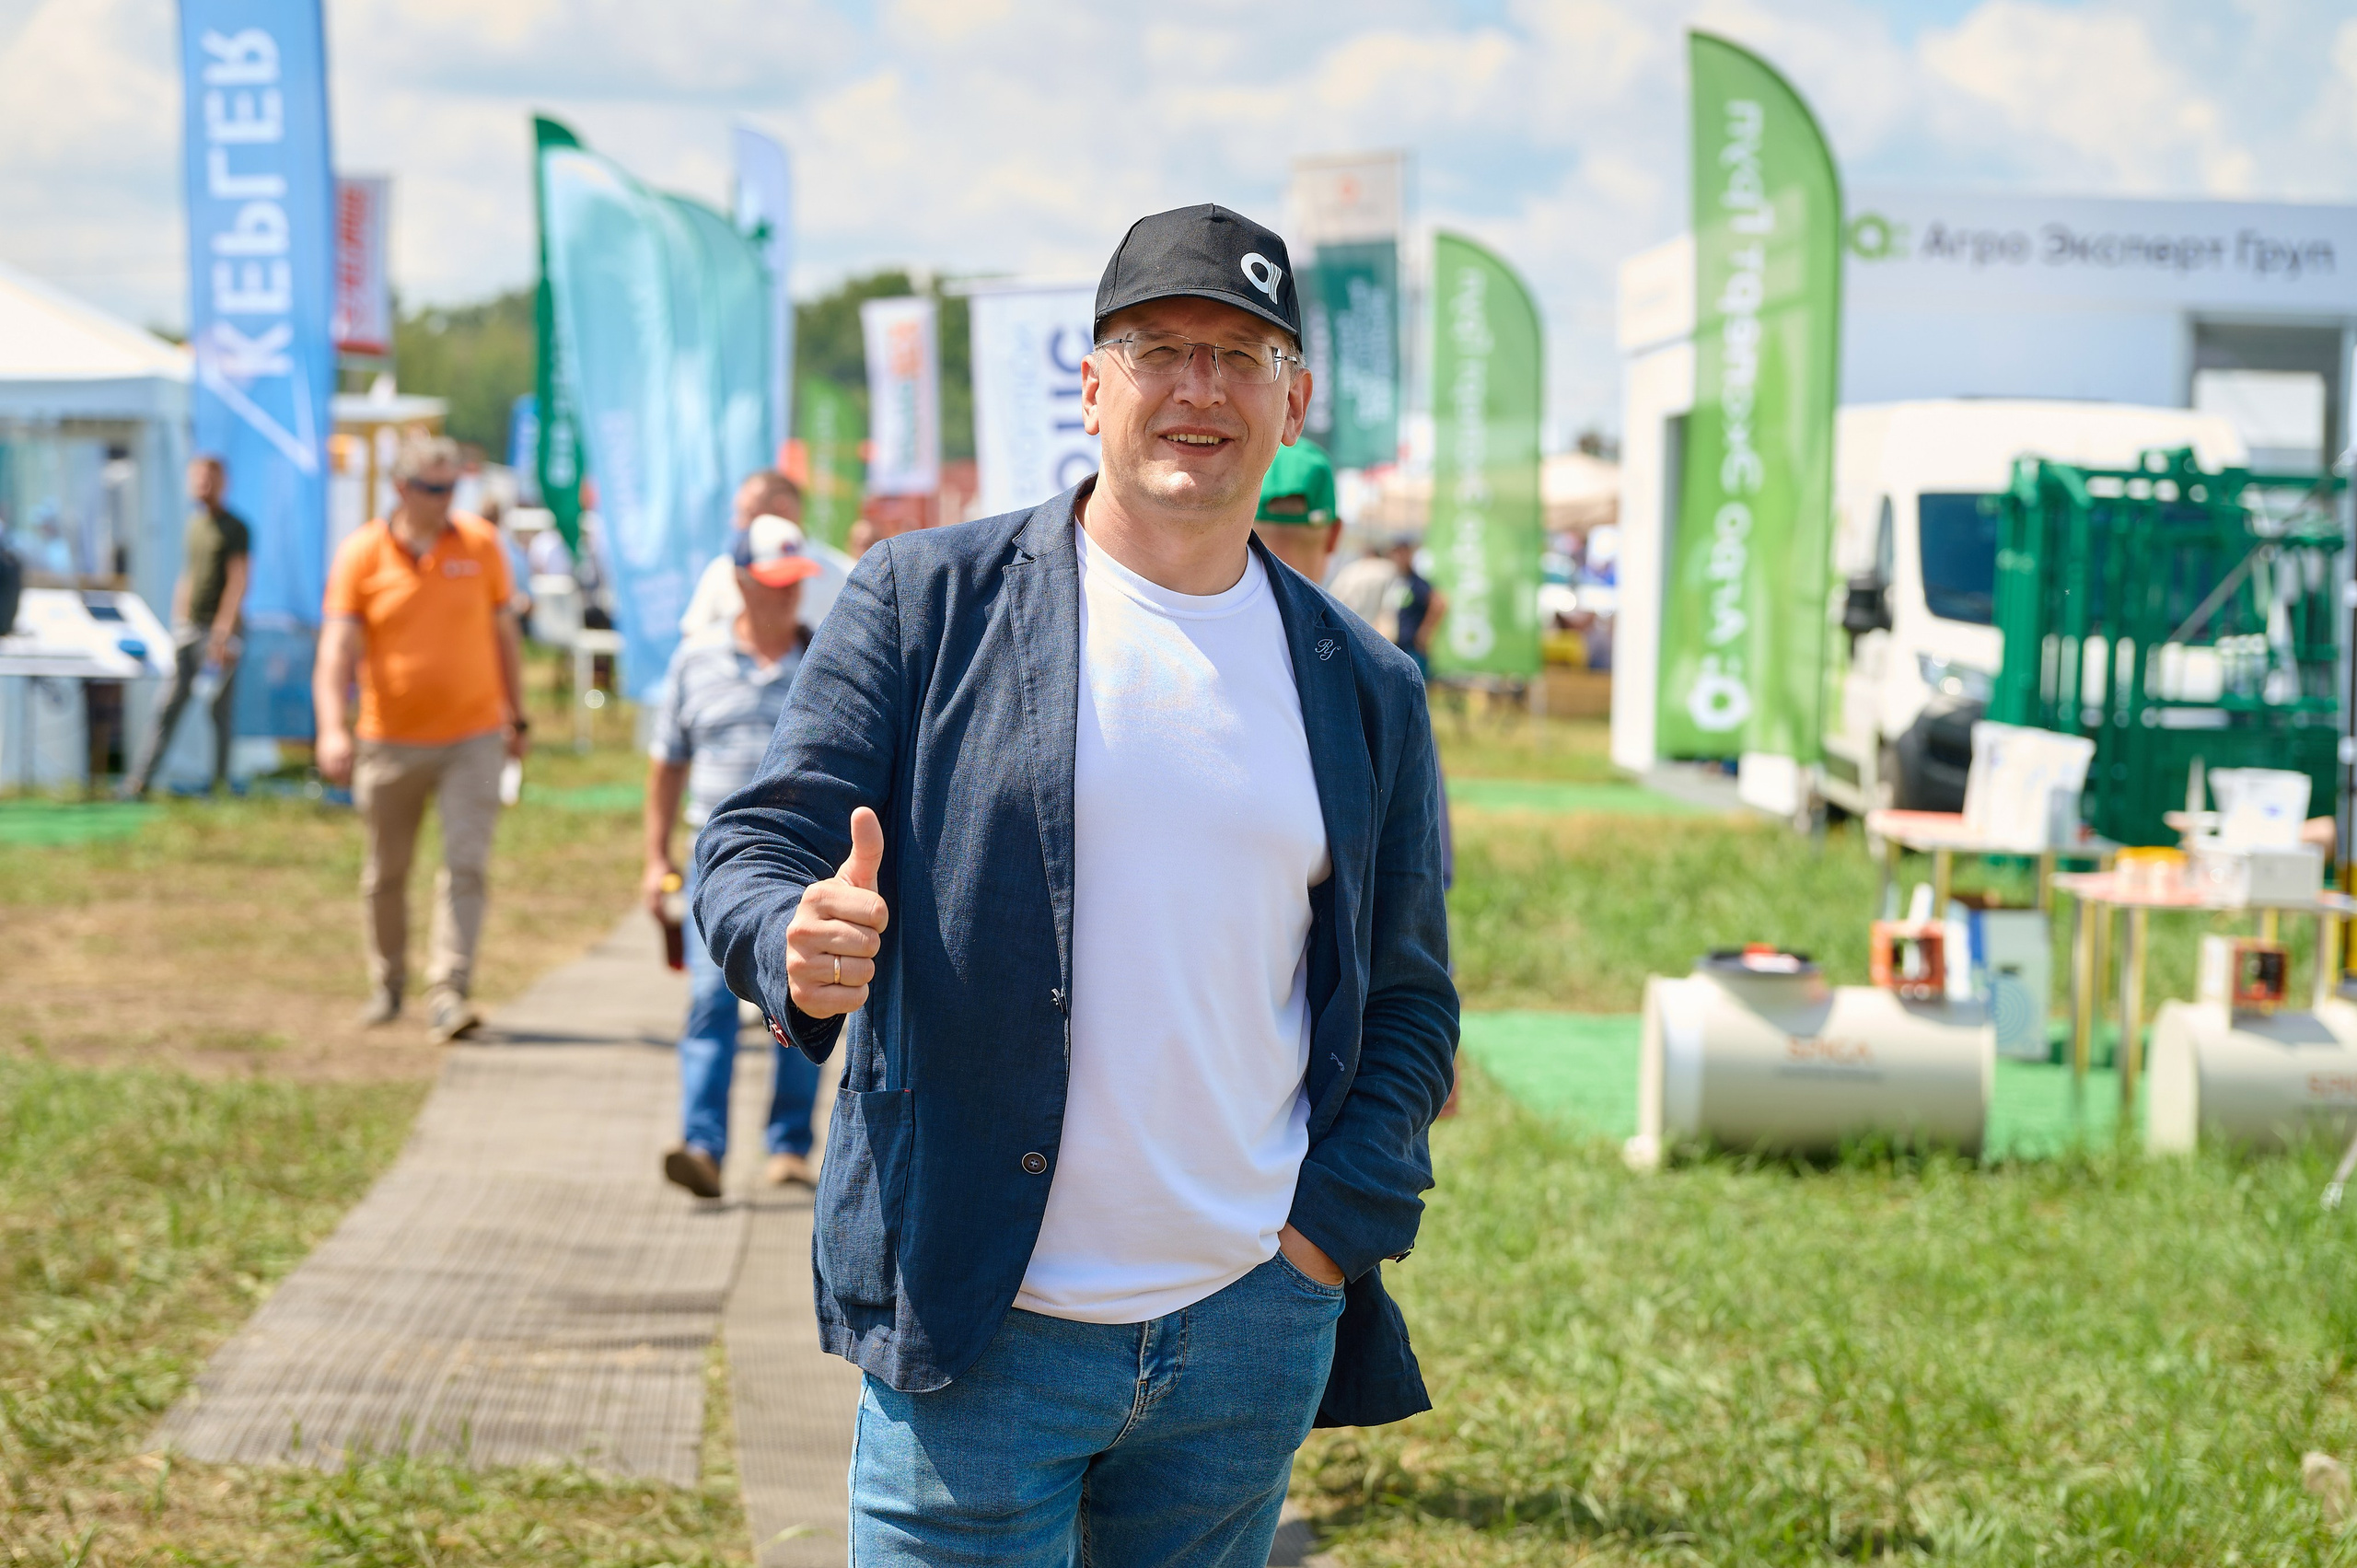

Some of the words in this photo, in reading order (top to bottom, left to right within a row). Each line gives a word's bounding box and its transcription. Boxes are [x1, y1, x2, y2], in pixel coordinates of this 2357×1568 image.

[1920, 221, 2031, 269] Агро
[2038, 223, 2223, 277] Эксперт
[2235, 227, 2337, 279] Груп
